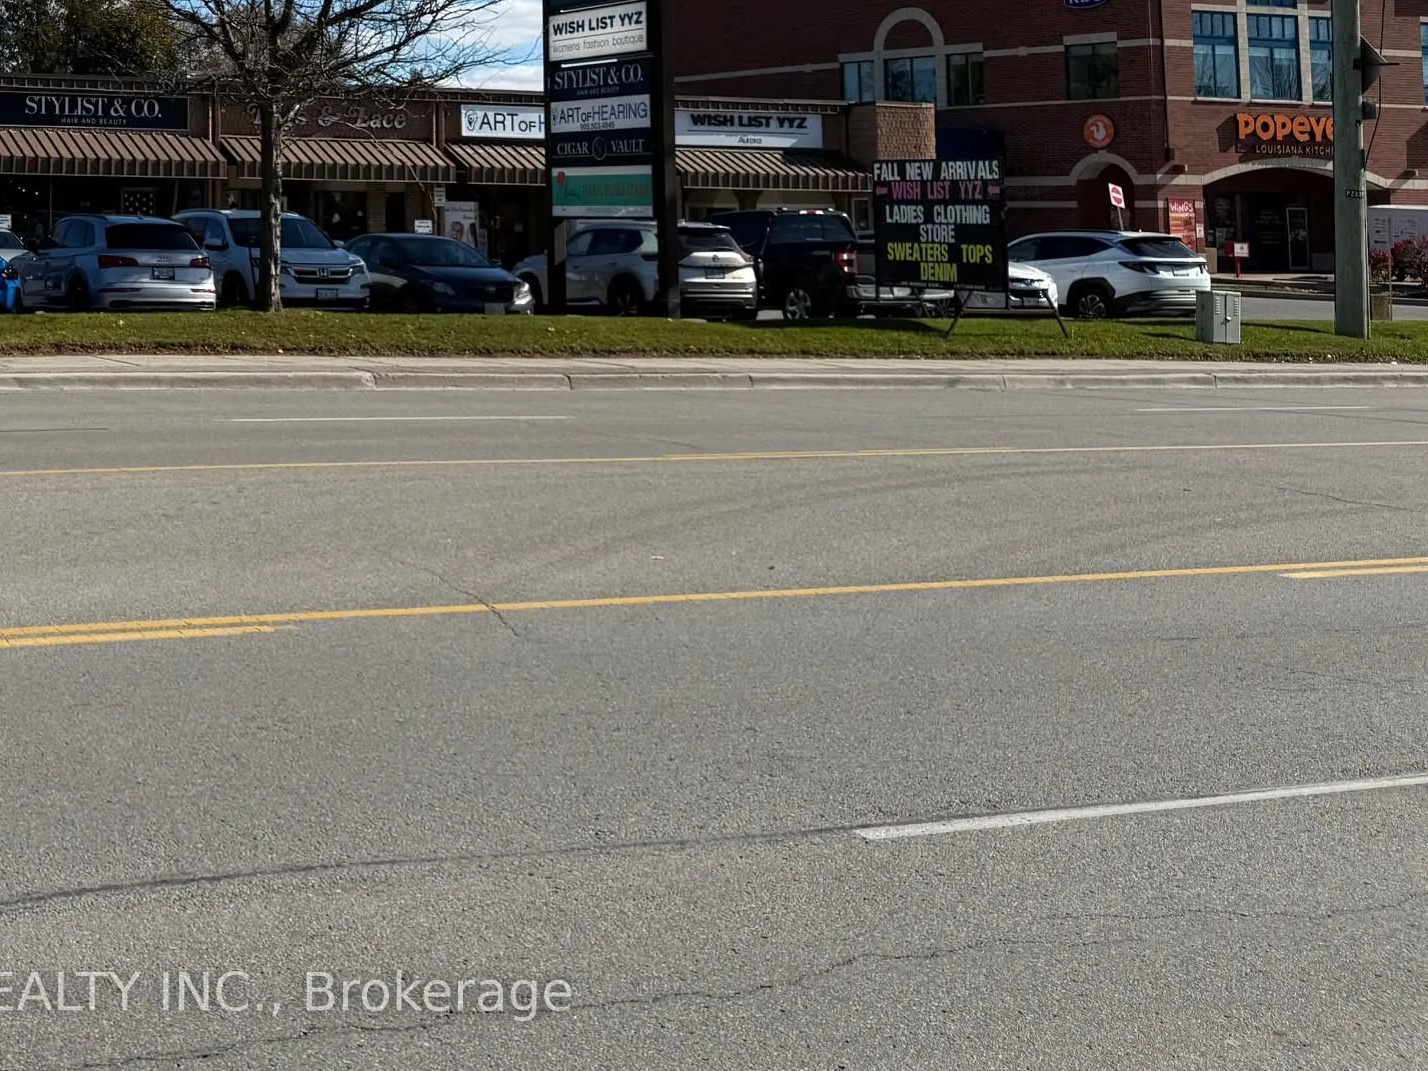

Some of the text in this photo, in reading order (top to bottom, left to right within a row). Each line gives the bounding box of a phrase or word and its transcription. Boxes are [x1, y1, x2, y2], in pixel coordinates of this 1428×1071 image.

[553, 11, 643, 36] WISH LIST YYZ
[583, 39, 609, 50] fashion
[612, 34, 644, 47] boutique
[554, 63, 644, 90] STYLIST & CO.
[25, 95, 162, 118] STYLIST & CO.
[559, 107, 581, 124] ART
[581, 112, 592, 123] OF
[592, 102, 648, 121] HEARING
[61, 116, 127, 126] HAIR AND BEAUTY
[479, 112, 518, 131] ART
[518, 120, 537, 132] OF
[690, 113, 808, 129] WISH LIST YYZ
[557, 141, 589, 155] CIGAR
[611, 138, 645, 153] VAULT
[738, 136, 763, 145] Aurora
[1255, 144, 1303, 156] LOUISIANA
[873, 159, 999, 181] FALL NEW ARRIVALS
[891, 180, 983, 200] WISH LIST YYZ
[885, 205, 990, 224] LADIES CLOTHING
[919, 223, 956, 243] STORE
[887, 242, 993, 264] SWEATERS TOPS
[920, 262, 958, 282] DENIM
